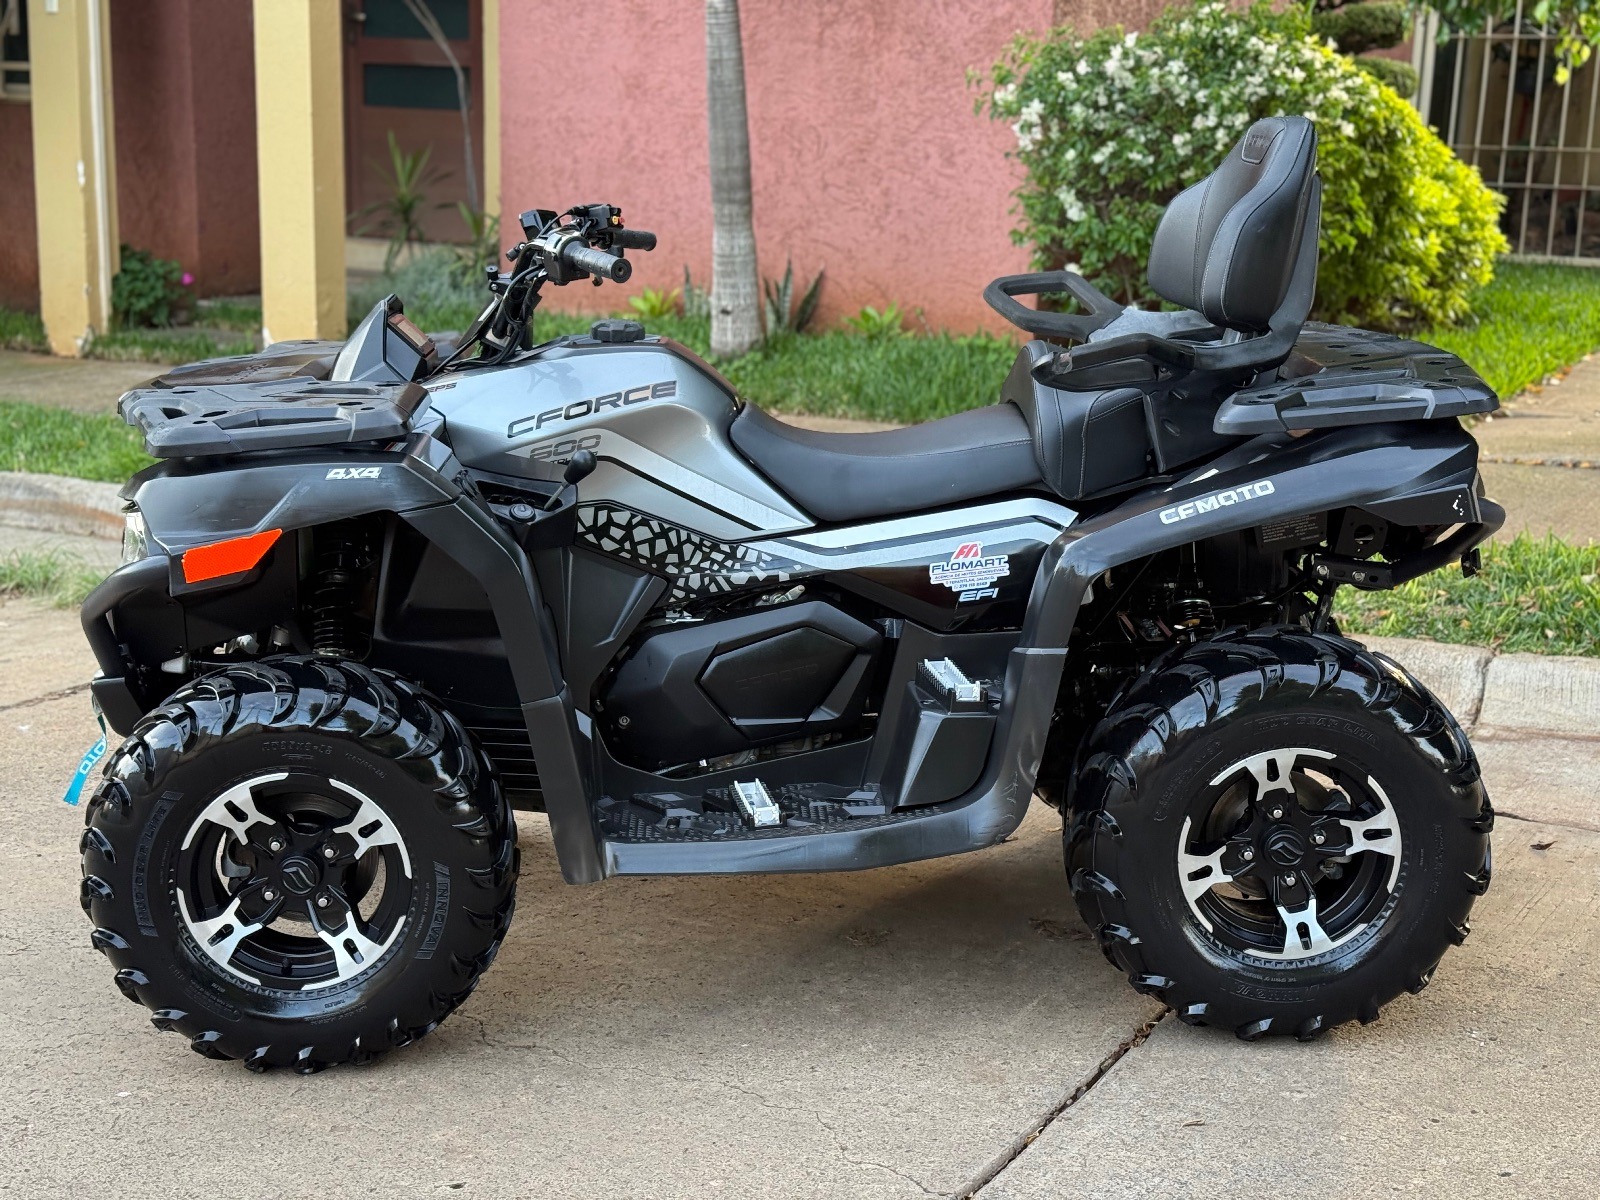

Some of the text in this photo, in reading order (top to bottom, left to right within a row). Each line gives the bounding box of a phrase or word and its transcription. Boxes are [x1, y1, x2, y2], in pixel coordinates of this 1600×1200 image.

[426, 381, 457, 393] EPS
[507, 380, 677, 438] CFORCE
[530, 434, 601, 461] 600
[325, 467, 383, 480] 4X4
[1159, 480, 1275, 525] CFMOTO
[931, 556, 1006, 574] FLOMART
[959, 587, 999, 602] EFI
[426, 882, 449, 944] INNOVA
